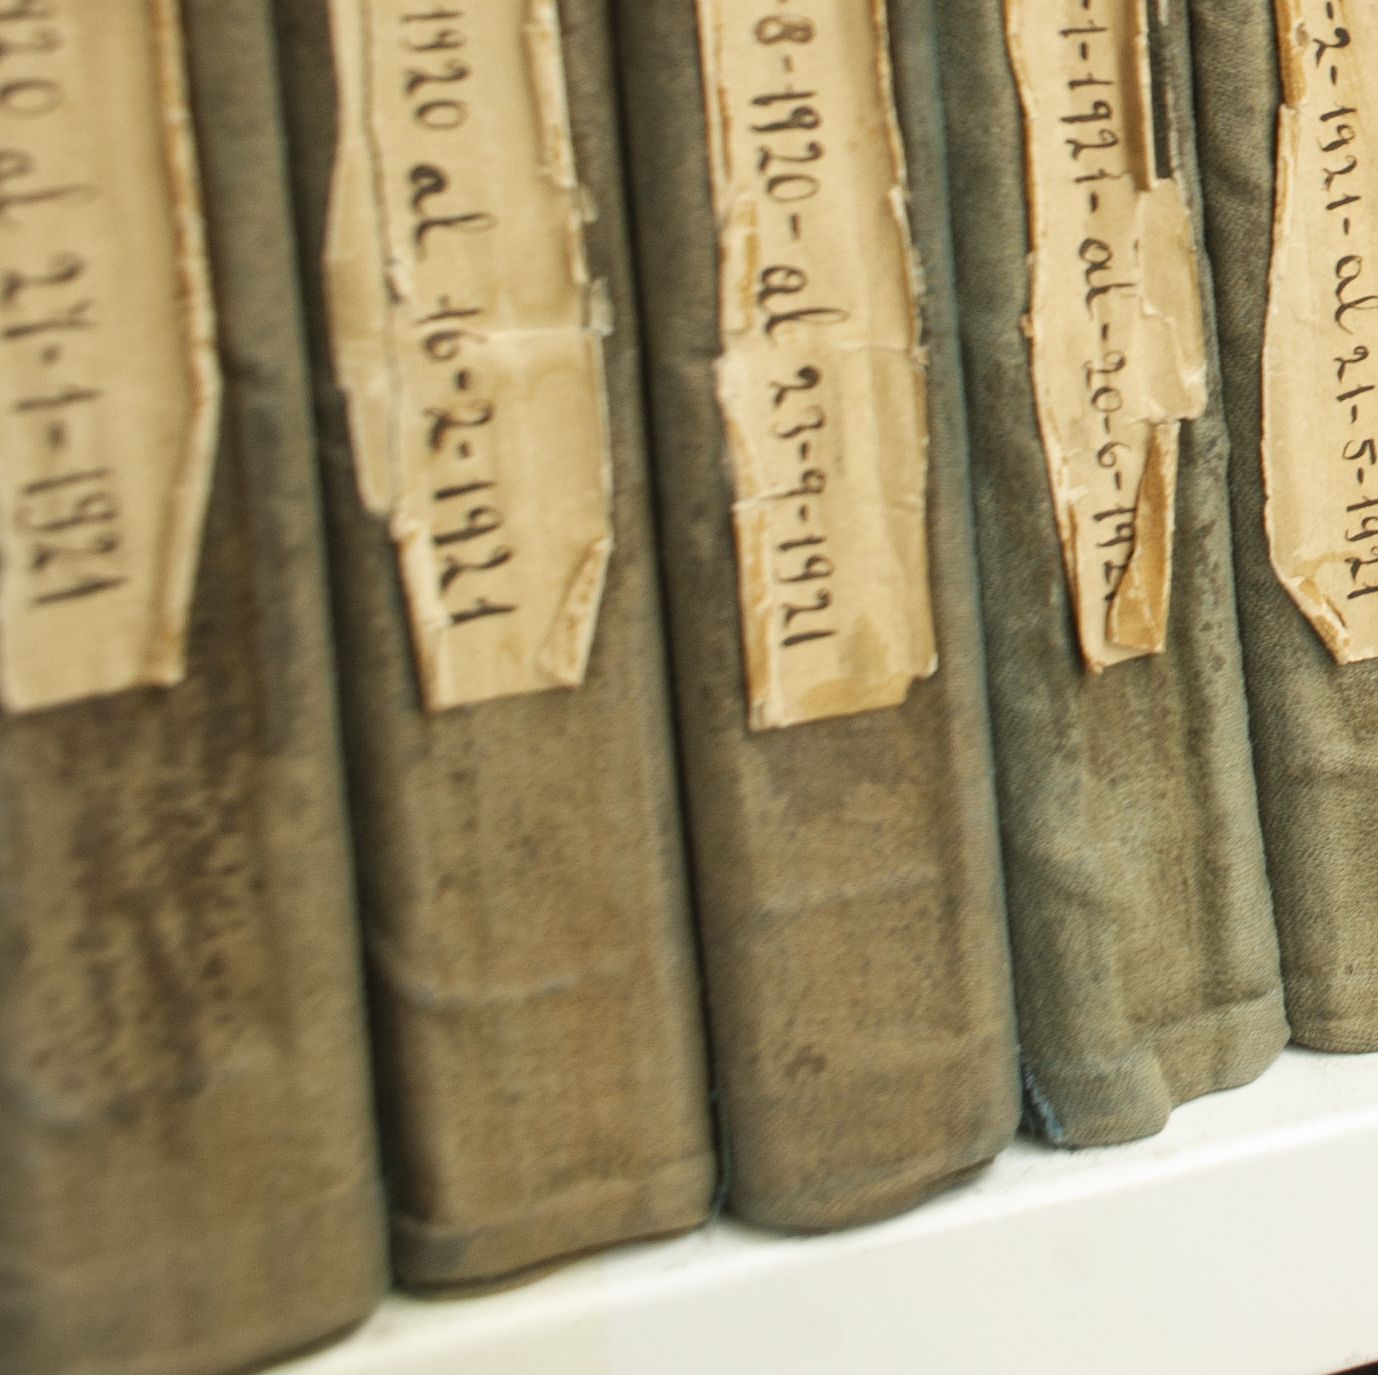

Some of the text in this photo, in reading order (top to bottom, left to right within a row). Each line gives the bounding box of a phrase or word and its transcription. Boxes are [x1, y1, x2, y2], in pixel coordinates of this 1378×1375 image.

[406, 162, 498, 260] al
[757, 266, 847, 337] al
[1080, 237, 1136, 306] al
[767, 364, 838, 648] 23-9-1921
